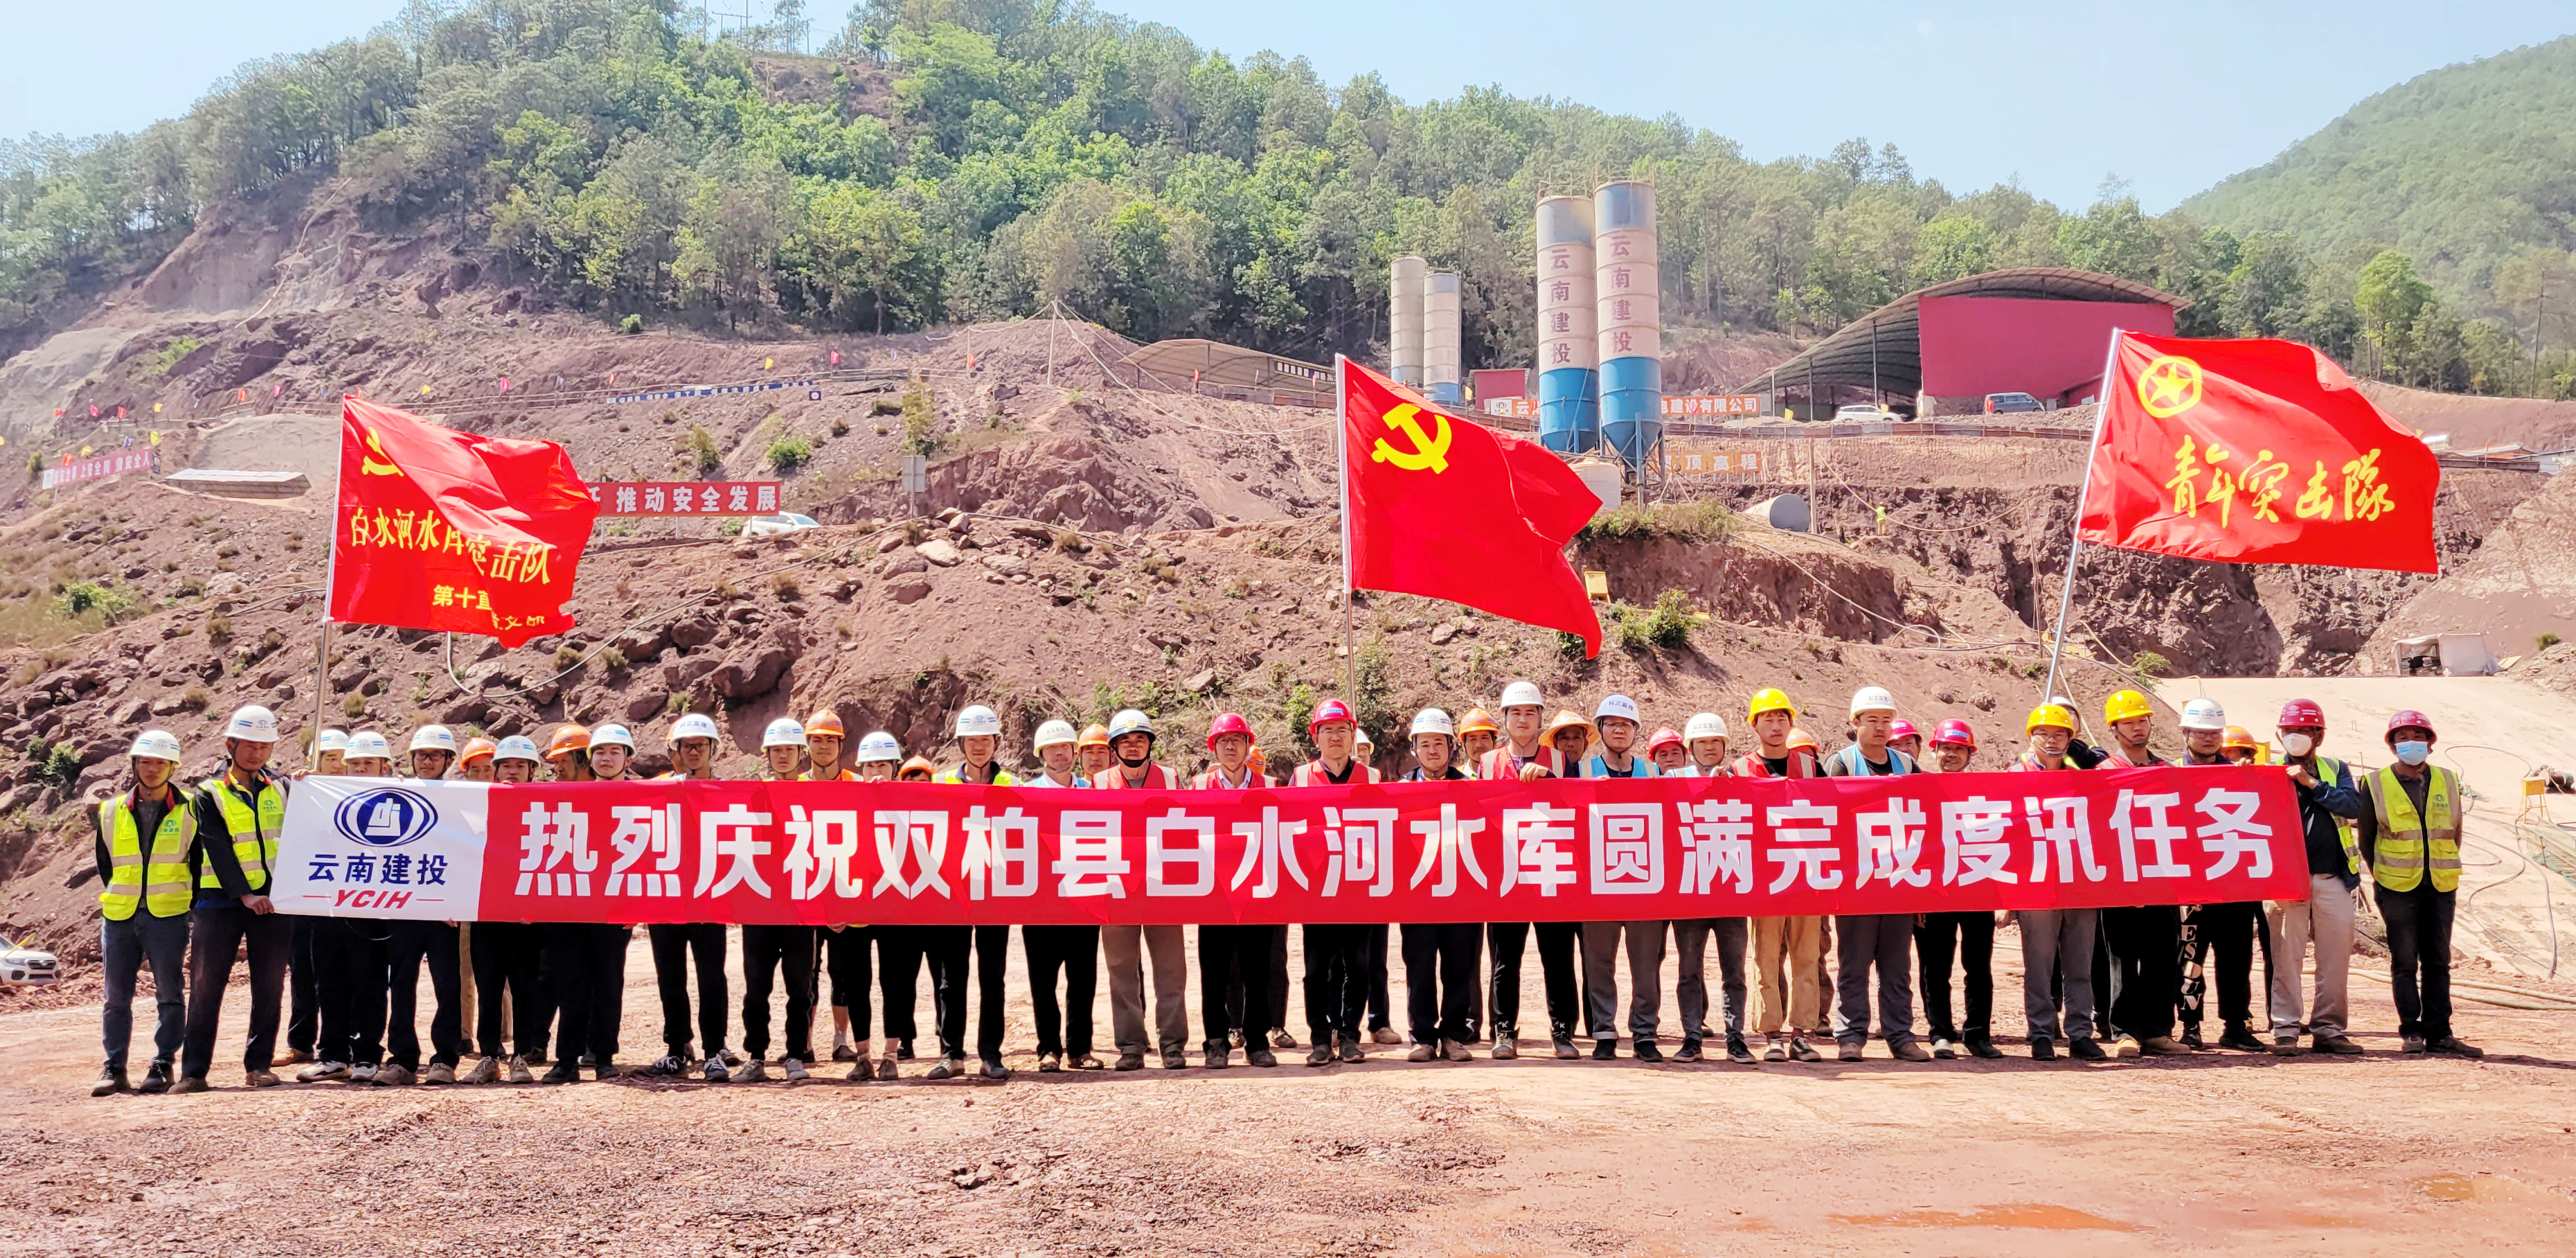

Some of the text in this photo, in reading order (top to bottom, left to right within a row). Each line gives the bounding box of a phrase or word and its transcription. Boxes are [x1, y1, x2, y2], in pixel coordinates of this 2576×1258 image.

[1550, 249, 1571, 364] 云南建投
[1611, 236, 1633, 354] 云南建投
[616, 486, 776, 513] 推动安全发展
[308, 853, 449, 886] 云南建投
[515, 787, 2273, 900] 热烈庆祝双柏县白水河水库圆满完成度汛任务
[332, 890, 414, 909] YCIH
